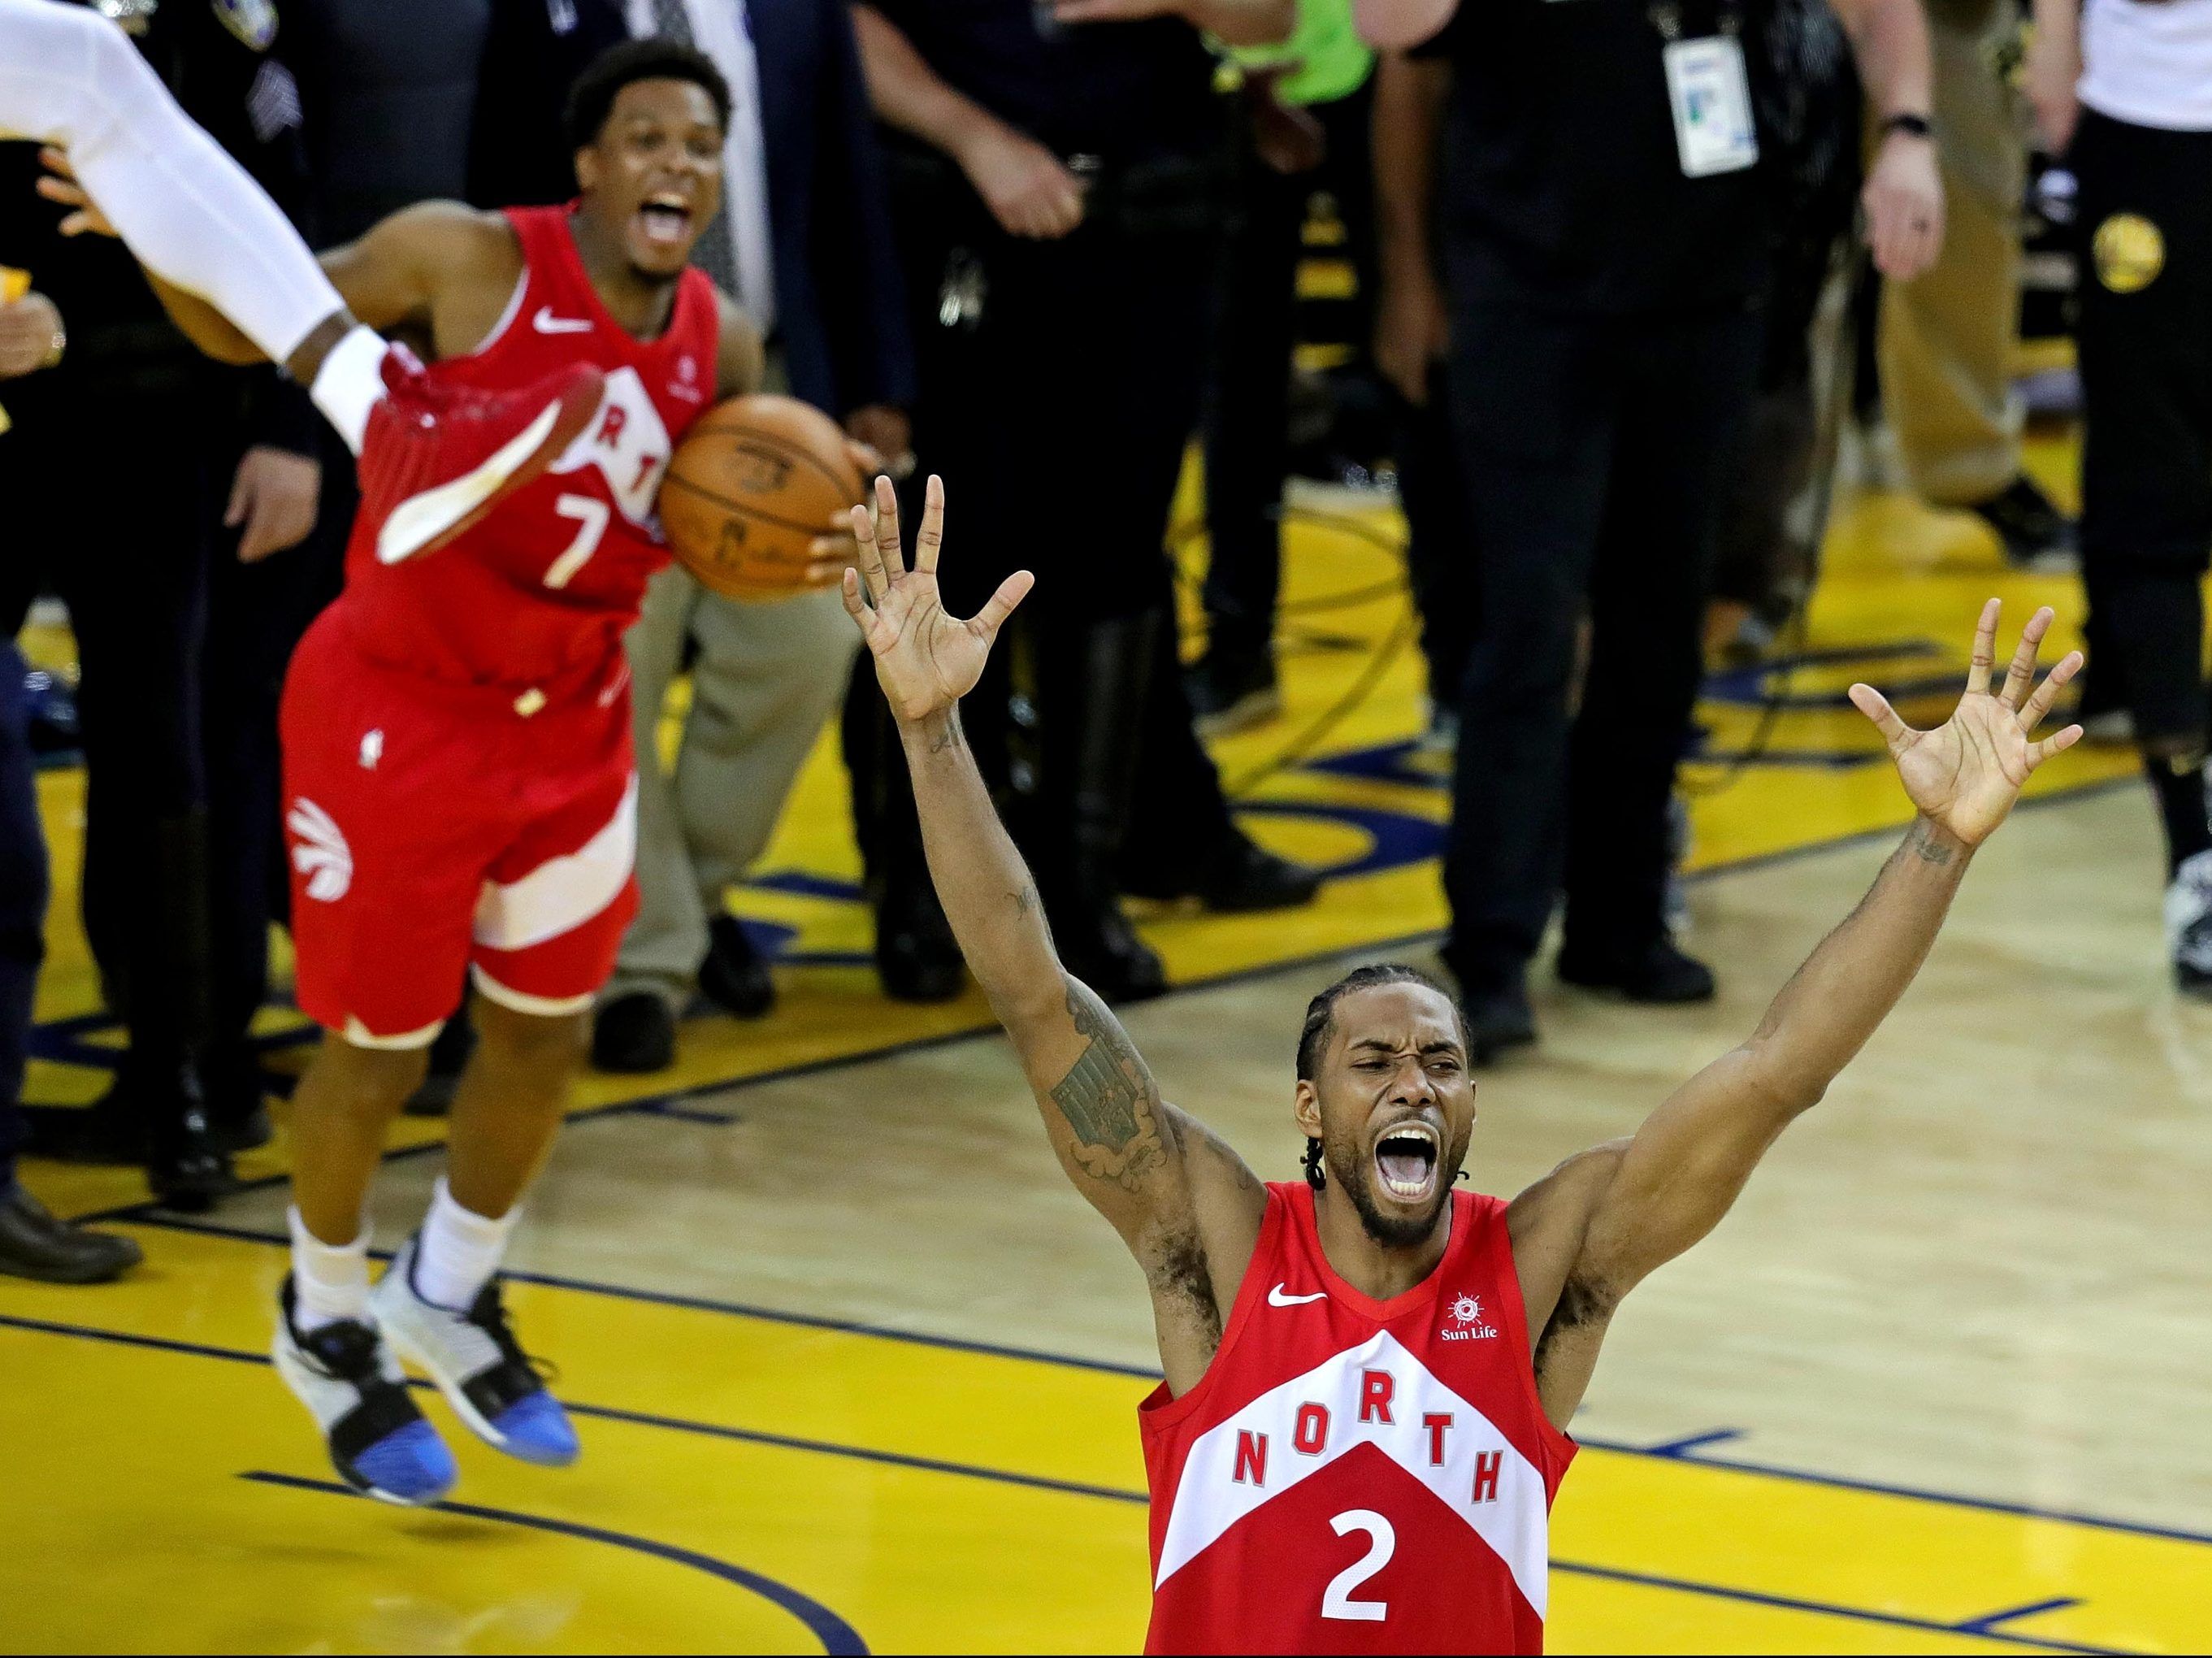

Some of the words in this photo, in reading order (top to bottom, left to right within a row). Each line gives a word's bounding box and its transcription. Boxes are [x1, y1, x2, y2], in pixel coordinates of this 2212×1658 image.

[542, 493, 611, 590] 7
[1441, 1329, 1469, 1341] Sun
[1471, 1325, 1498, 1339] Life
[1232, 1367, 1504, 1504] NORTH
[1321, 1508, 1396, 1621] 2
